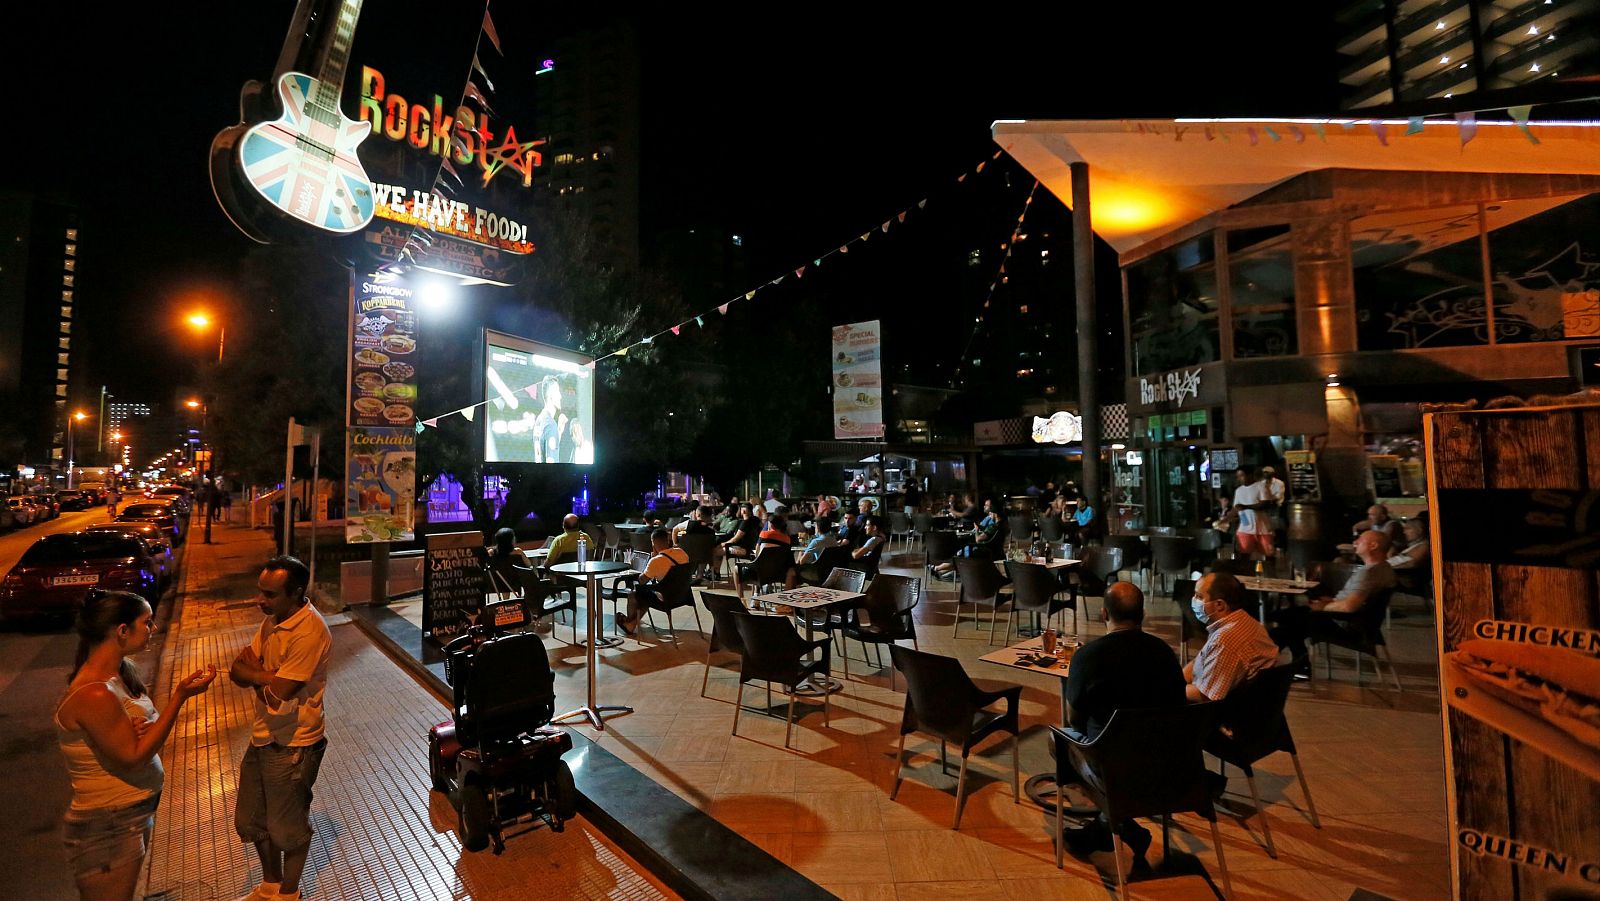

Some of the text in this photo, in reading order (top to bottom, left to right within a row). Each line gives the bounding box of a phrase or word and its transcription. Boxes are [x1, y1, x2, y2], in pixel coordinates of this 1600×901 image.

[371, 181, 527, 244] WE HAVE FOOD!
[362, 281, 413, 298] STRONGBOW
[849, 331, 875, 340] SPECIAL
[353, 433, 413, 445] Cocktails
[1474, 620, 1600, 656] CHICKEN
[1458, 830, 1568, 874] QUEEN
